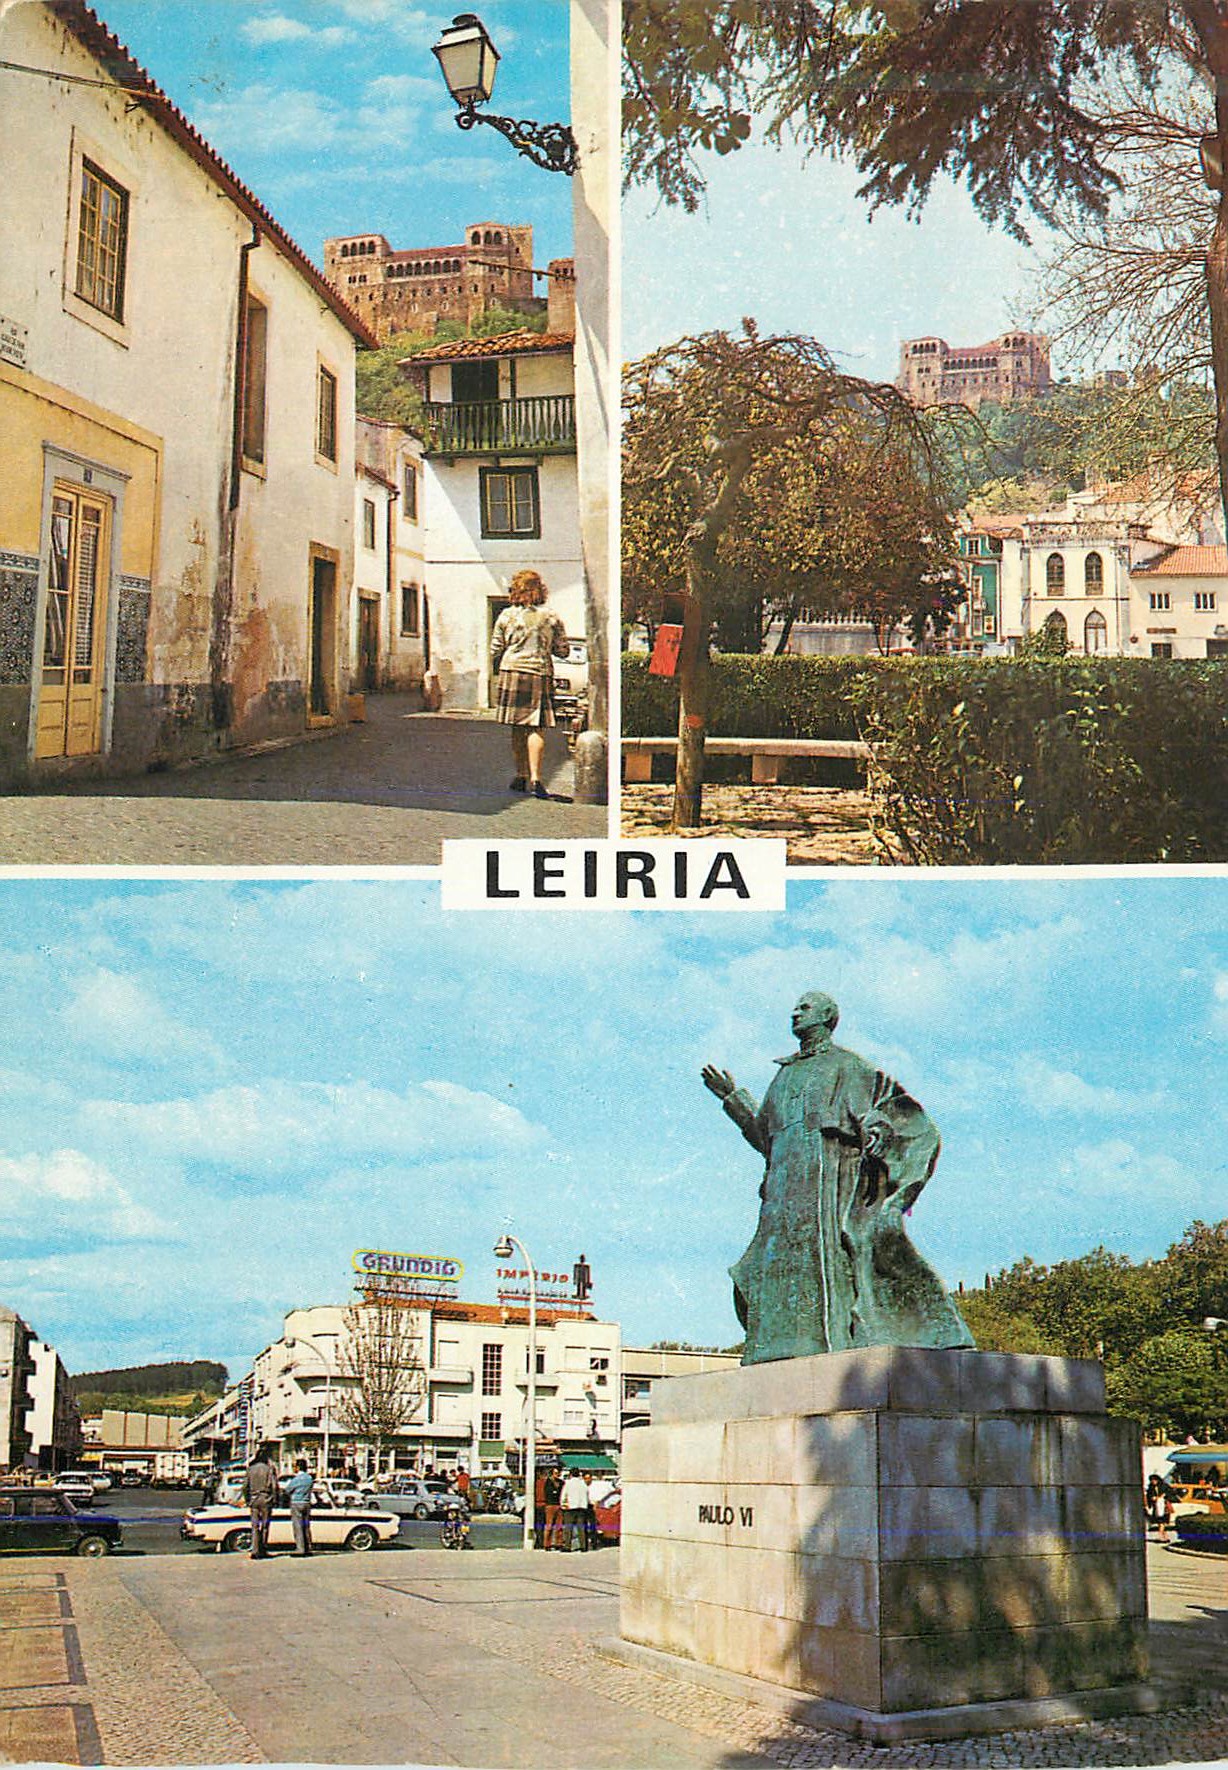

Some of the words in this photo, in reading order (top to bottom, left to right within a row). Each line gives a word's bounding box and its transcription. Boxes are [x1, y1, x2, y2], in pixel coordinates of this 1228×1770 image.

[362, 1252, 456, 1276] GRUNDIG
[699, 1505, 735, 1525] PAULO
[739, 1507, 754, 1527] VI
